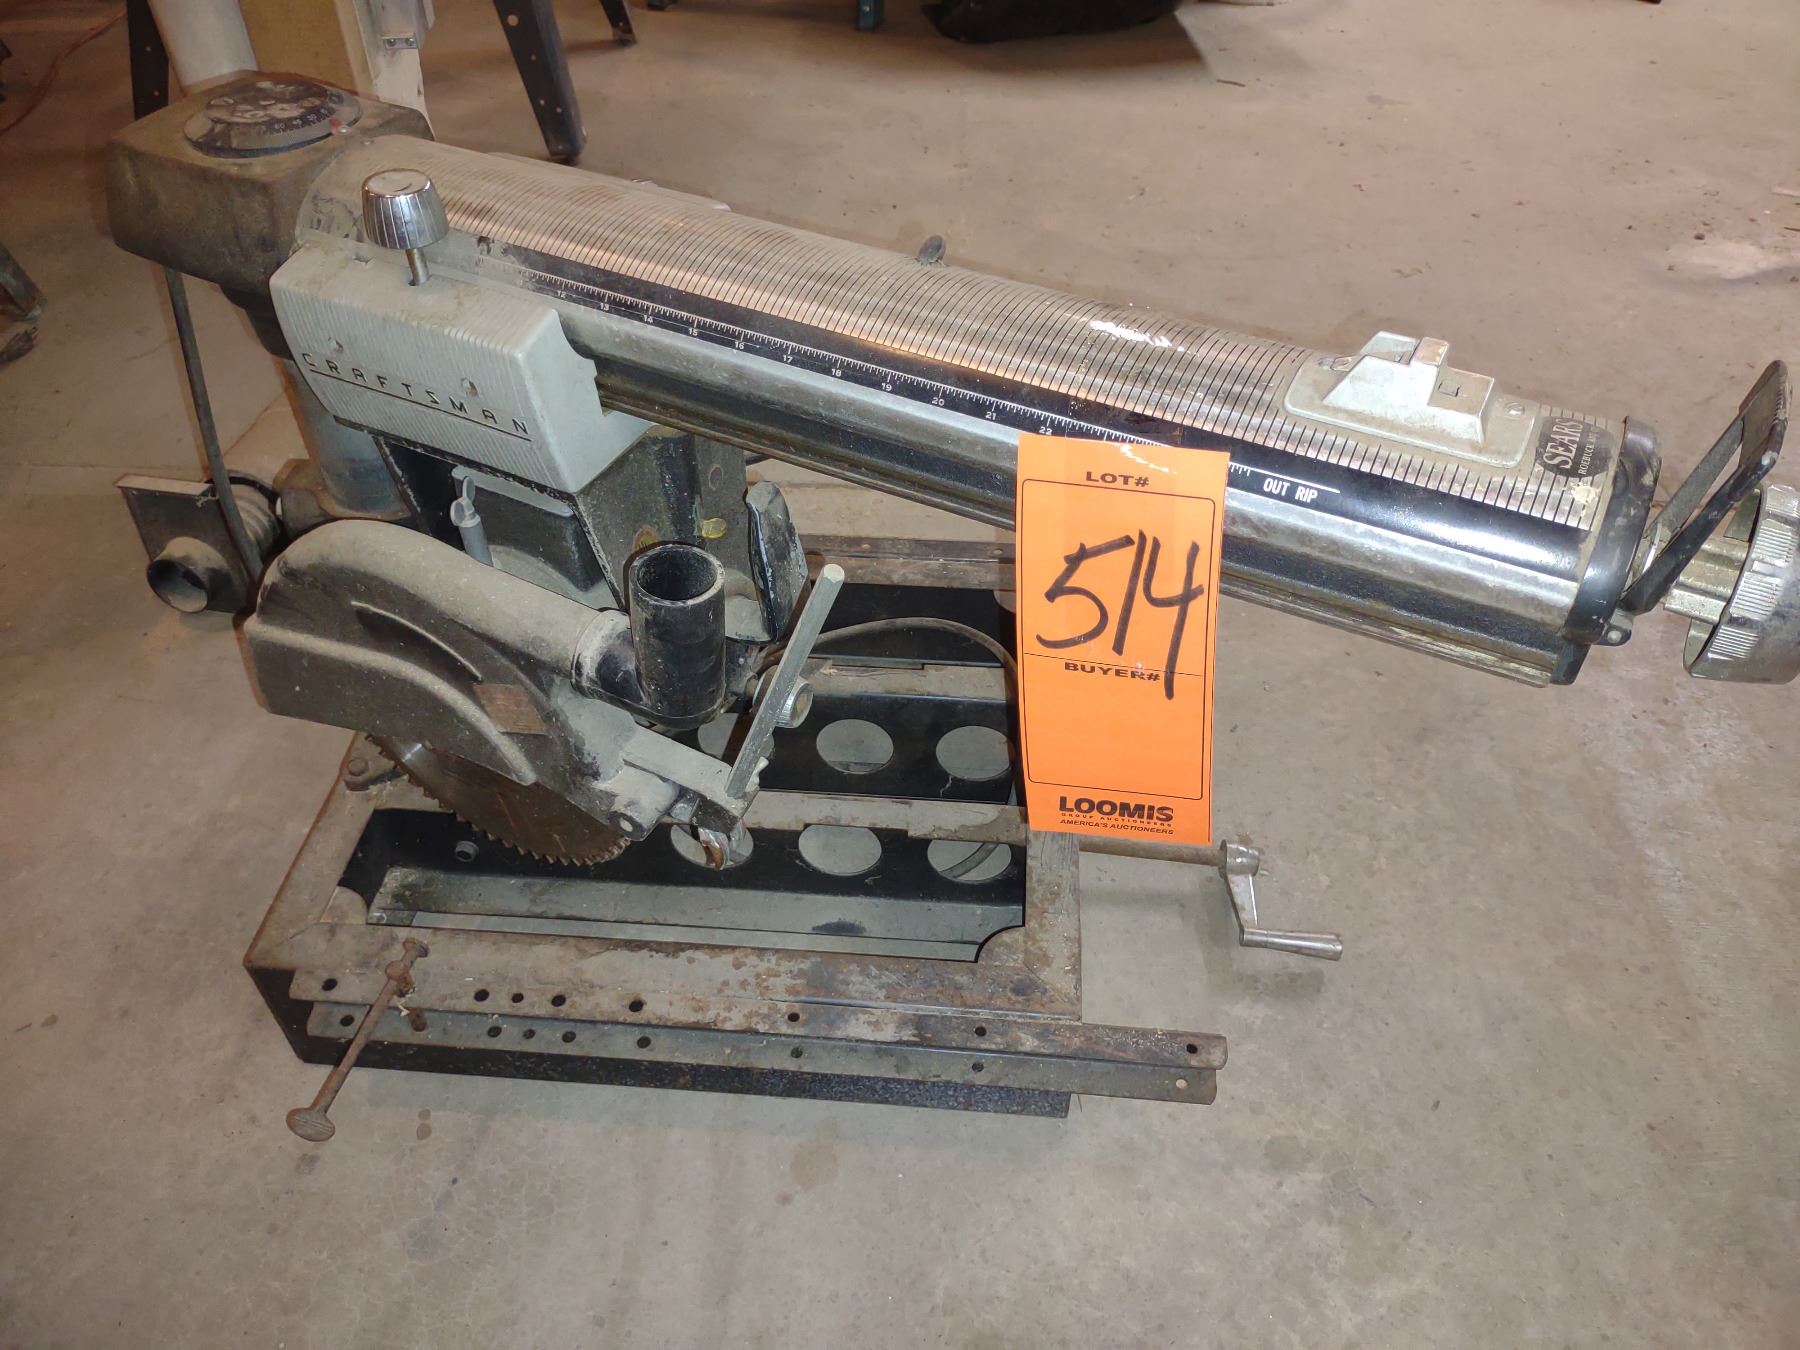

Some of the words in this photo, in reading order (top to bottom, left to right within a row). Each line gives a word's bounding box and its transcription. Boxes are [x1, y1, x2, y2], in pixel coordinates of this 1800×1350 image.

[557, 290, 566, 299] 12
[601, 302, 610, 311] 13
[643, 315, 653, 324] 14
[688, 328, 698, 336] 15
[734, 341, 745, 350] 16
[782, 355, 793, 364] 17
[831, 368, 842, 377] 18
[881, 382, 892, 392] 19
[931, 397, 945, 407] 20
[985, 411, 997, 421] 21
[1039, 426, 1053, 436] 22
[302, 353, 529, 435] CRAFTSMAN
[1543, 418, 1583, 470] SEARS
[1086, 471, 1150, 488] LOT#
[1263, 478, 1288, 496] OUT
[1294, 485, 1318, 503] RIP
[1036, 529, 1204, 700] 514
[1064, 662, 1161, 682] BUYER#
[1059, 796, 1174, 822] LOOMIS
[1100, 816, 1172, 827] AUCTIONEERS
[1060, 819, 1108, 828] AMERICA'S
[1110, 824, 1174, 835] AUCTIONEERS
